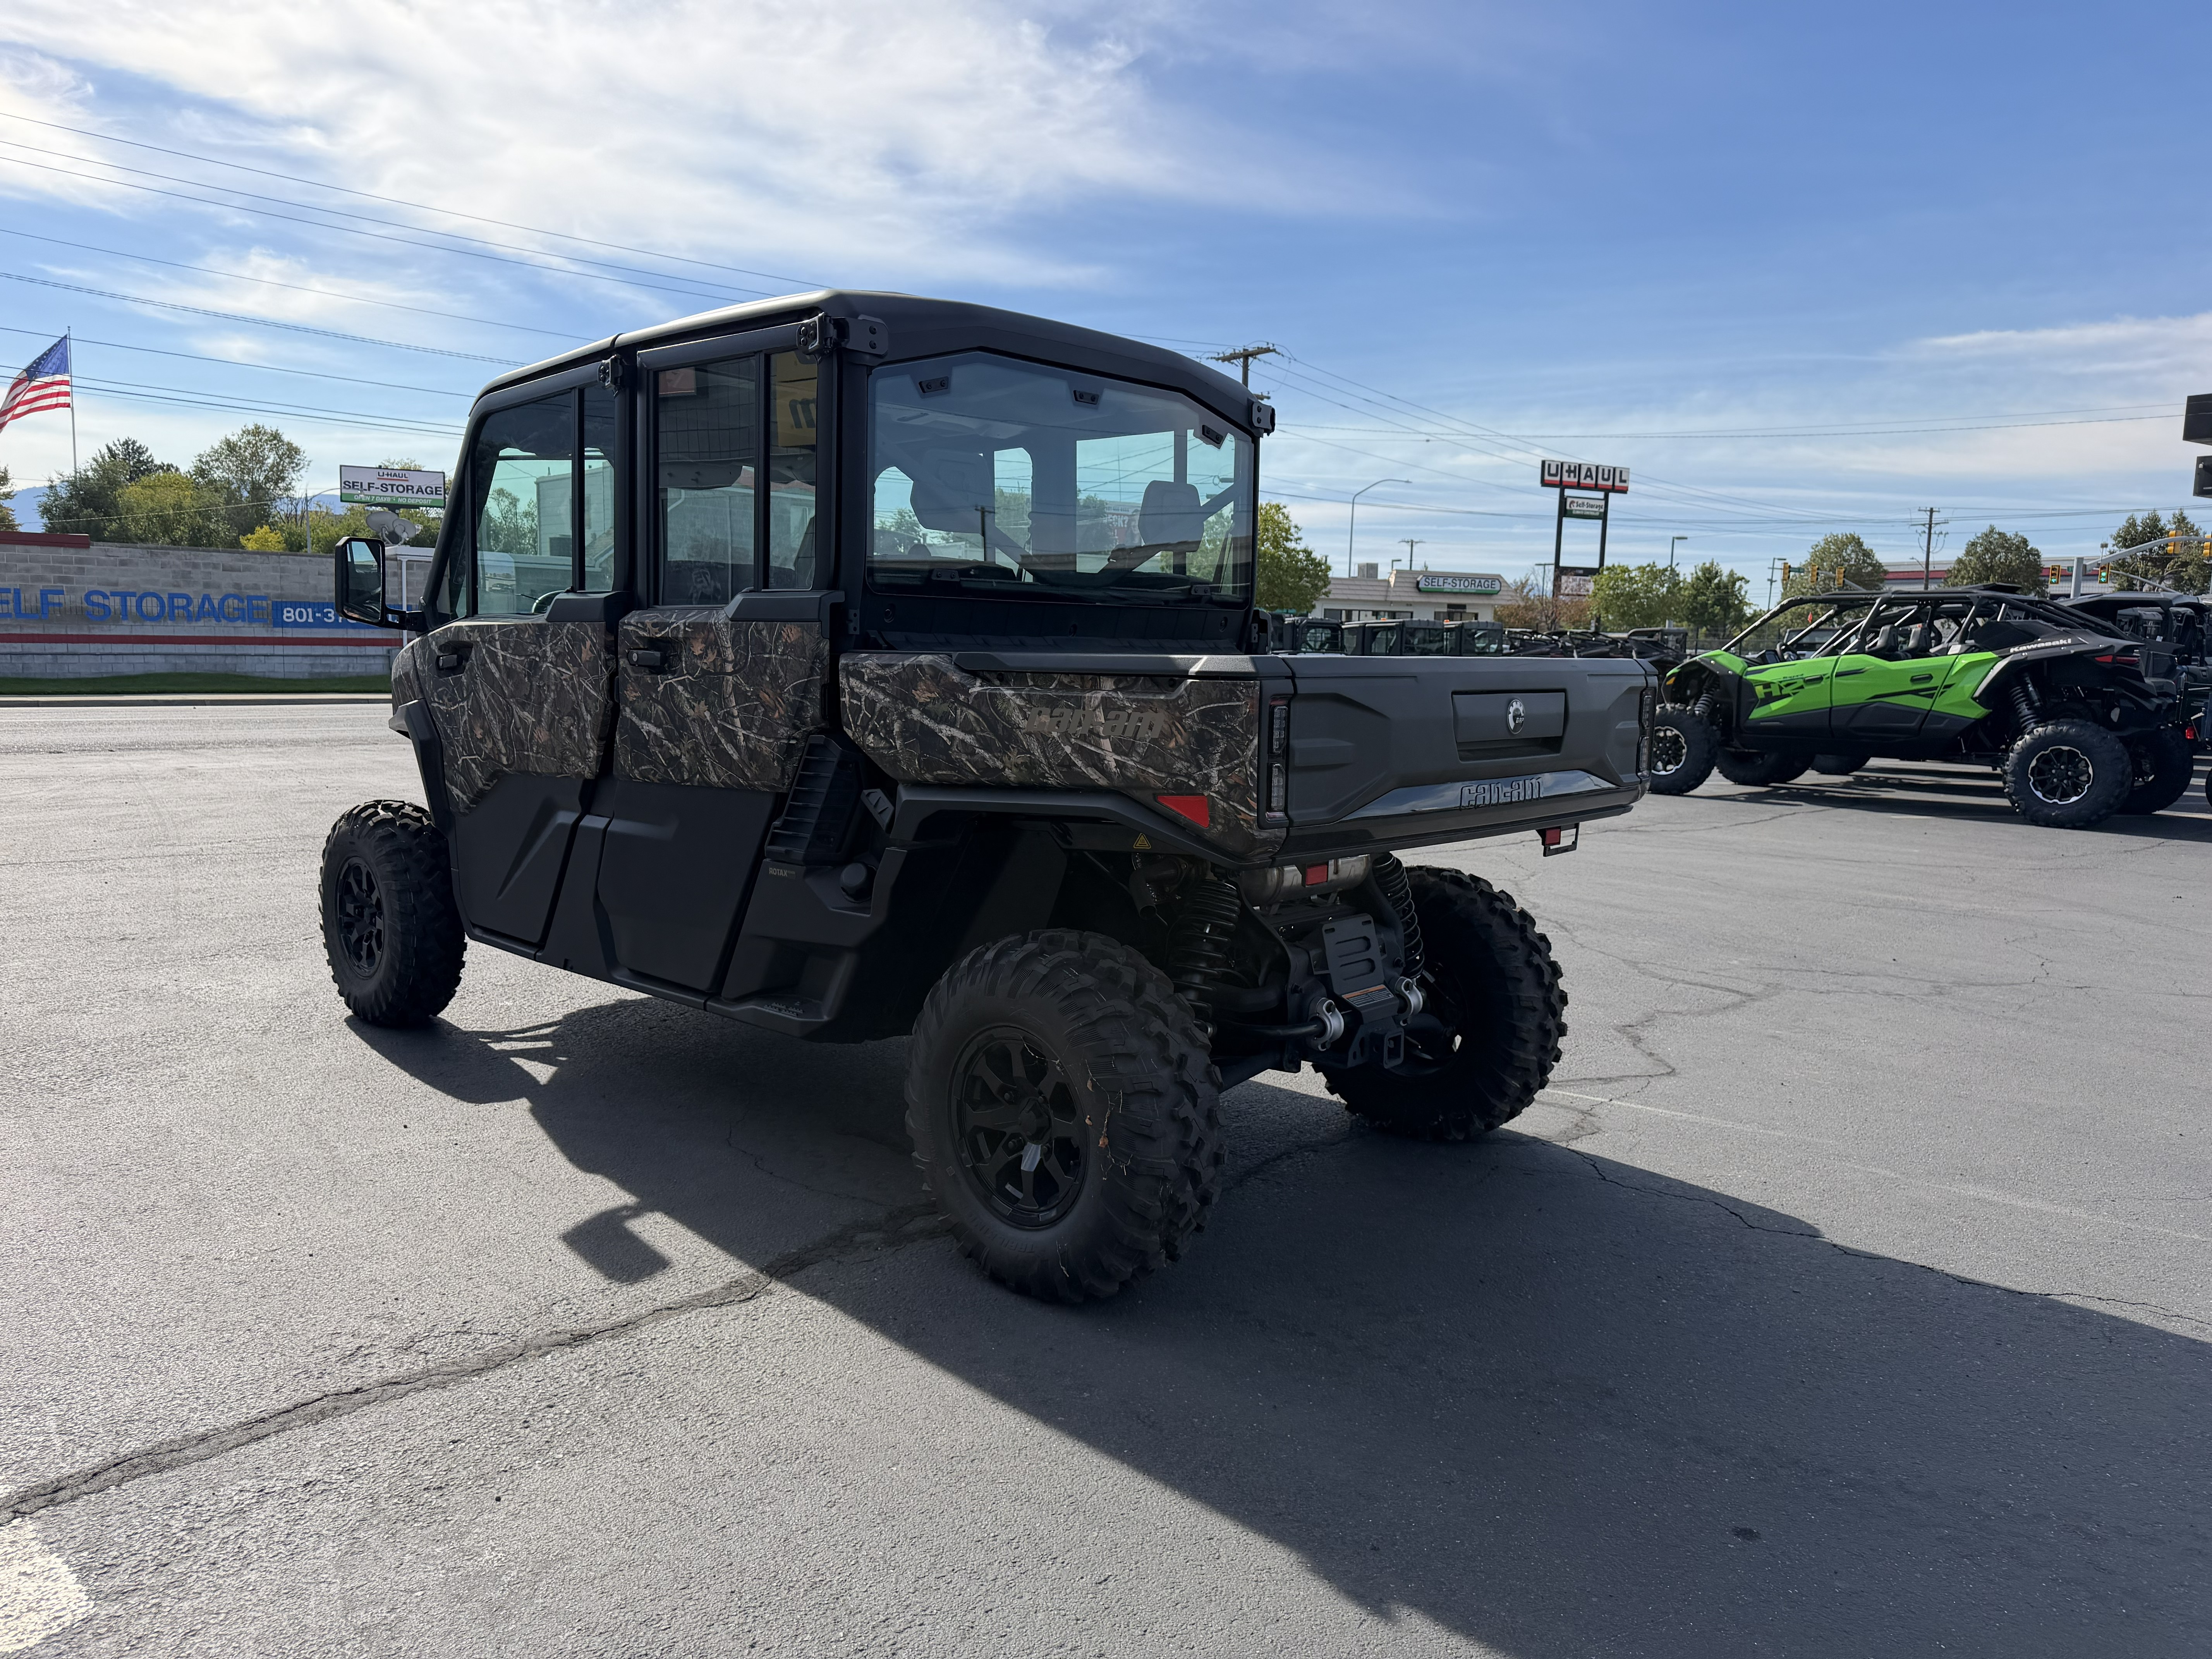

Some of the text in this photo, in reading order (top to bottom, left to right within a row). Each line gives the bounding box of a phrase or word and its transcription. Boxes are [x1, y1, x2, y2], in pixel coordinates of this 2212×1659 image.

[1547, 463, 1627, 483] U-HAUL
[343, 481, 443, 495] SELF-STORAGE
[1424, 577, 1496, 589] SELF-STORAGE
[84, 590, 268, 623] STORAGE
[2010, 639, 2071, 653] Kawasaki
[769, 867, 787, 877] ROTAX
